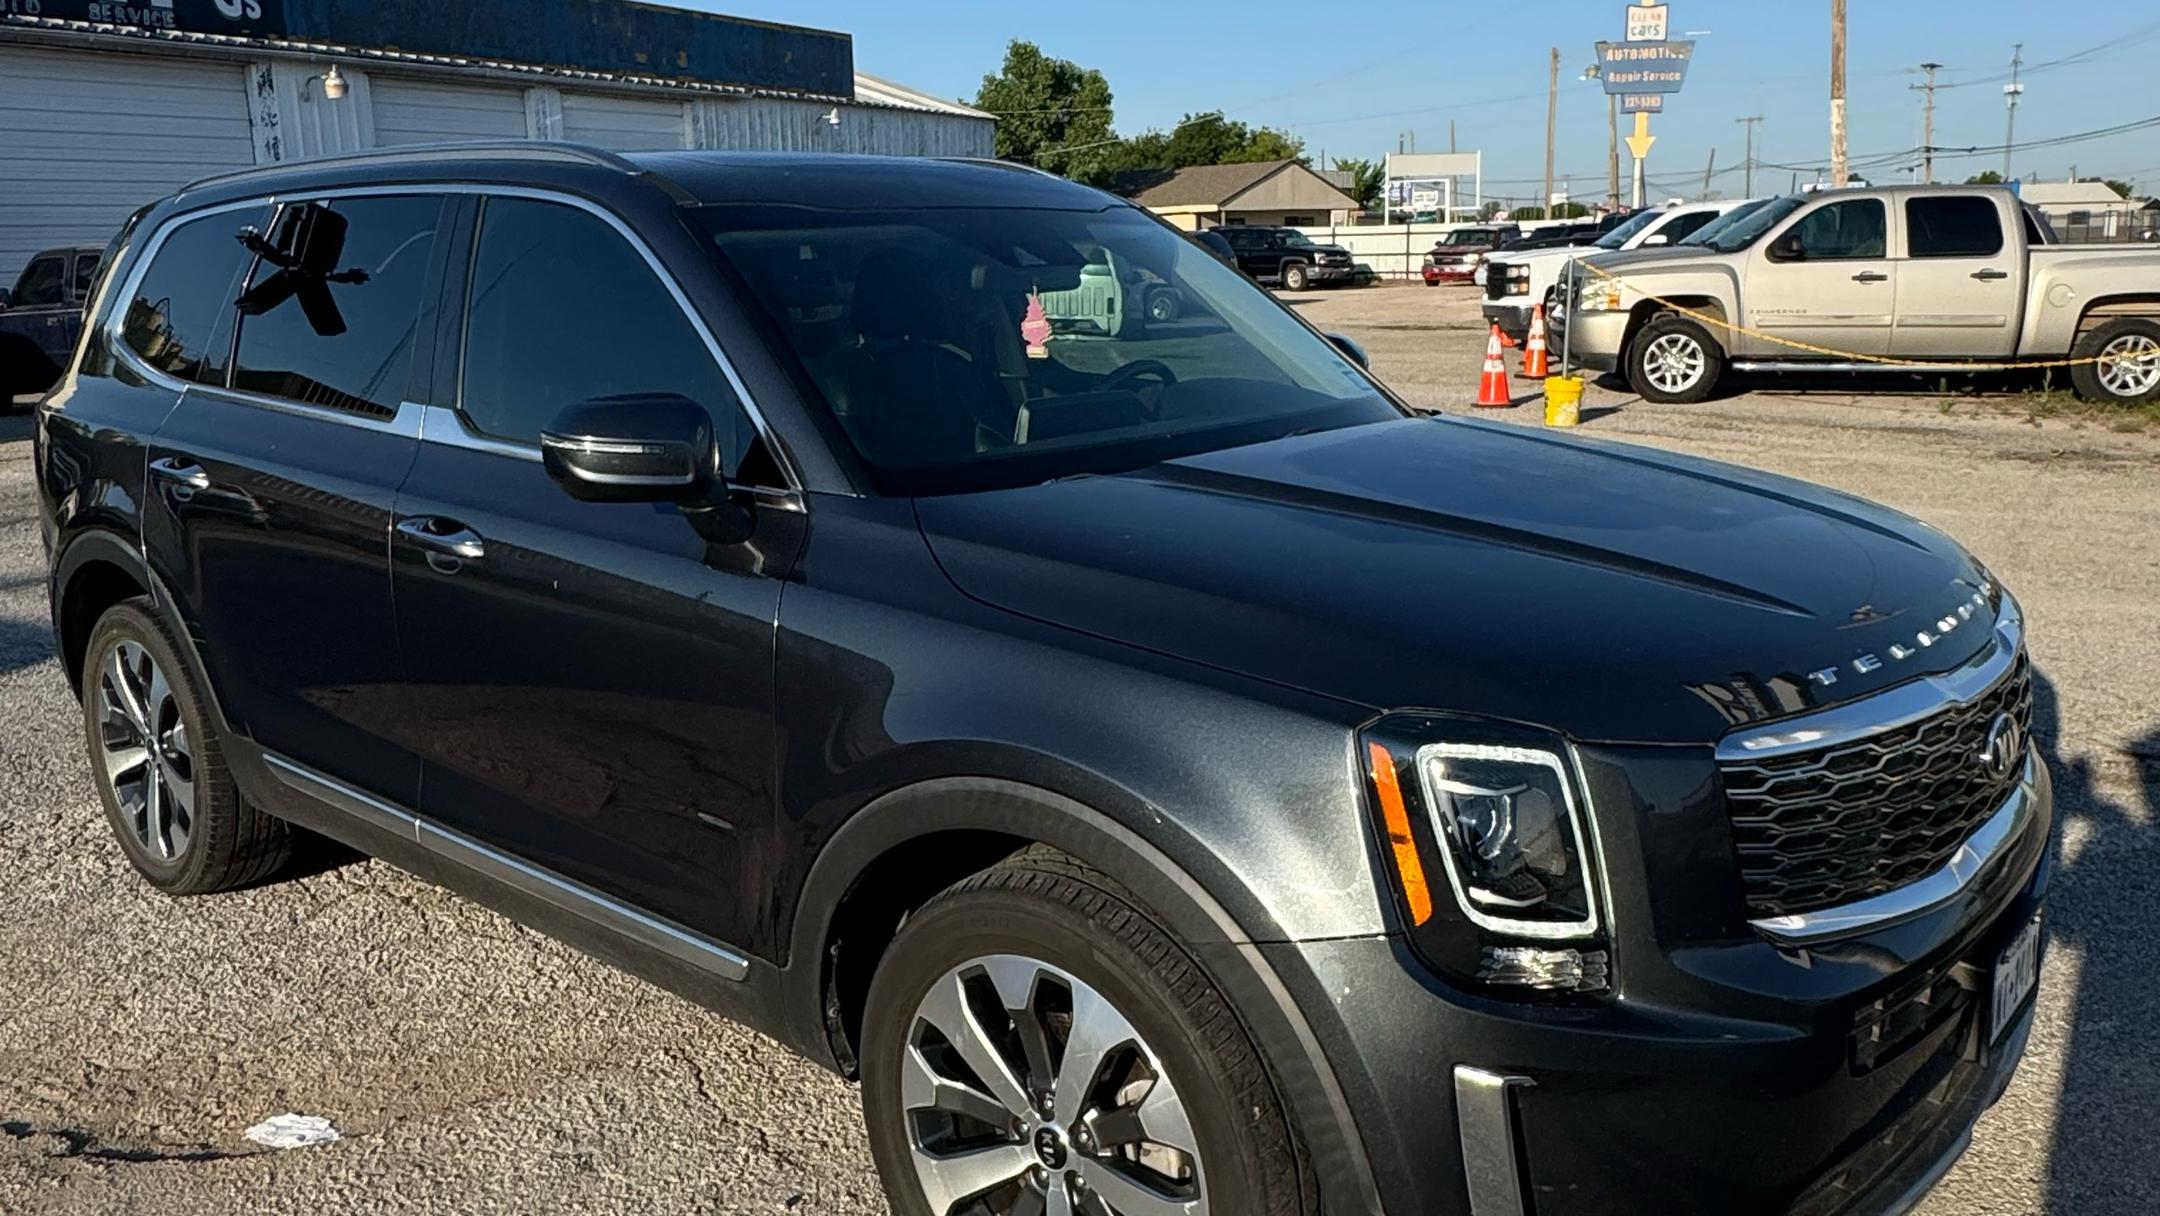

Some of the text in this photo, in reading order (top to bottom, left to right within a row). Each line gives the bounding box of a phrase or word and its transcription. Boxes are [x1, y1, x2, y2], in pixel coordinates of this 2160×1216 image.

[88, 3, 176, 33] SERVICE
[1608, 70, 1681, 83] Repair Service
[1041, 1132, 1057, 1166] KIA
